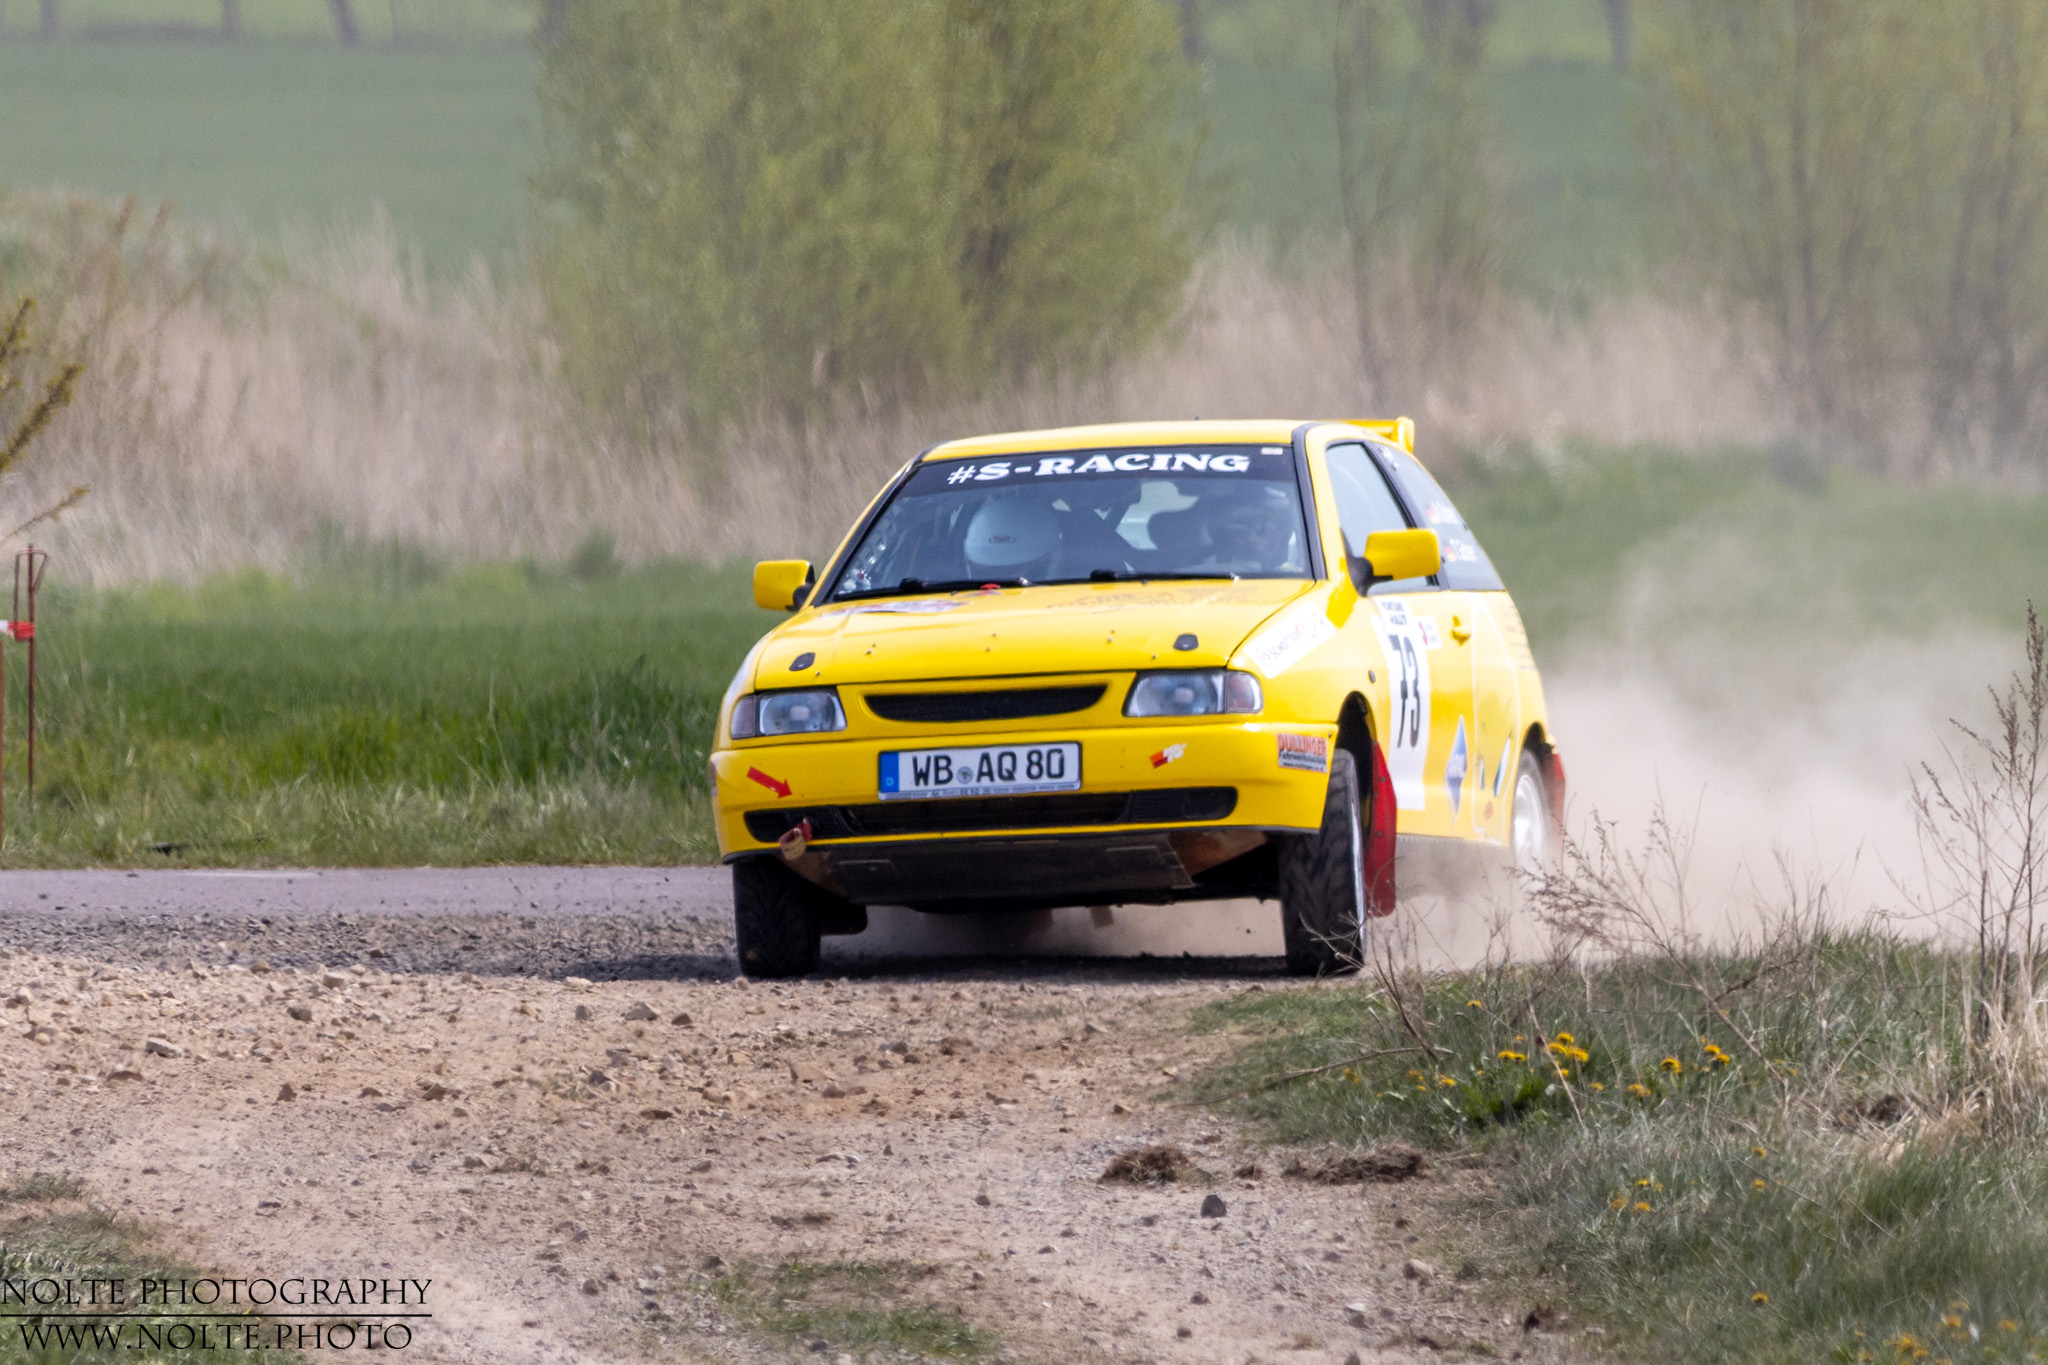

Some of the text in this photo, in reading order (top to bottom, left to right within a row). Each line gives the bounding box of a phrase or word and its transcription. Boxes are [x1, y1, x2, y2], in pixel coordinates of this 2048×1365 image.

[947, 454, 1250, 485] #S-RACING
[1387, 634, 1421, 749] 73
[912, 755, 953, 786] WB
[976, 752, 1017, 783] AQ
[1026, 749, 1066, 780] 80
